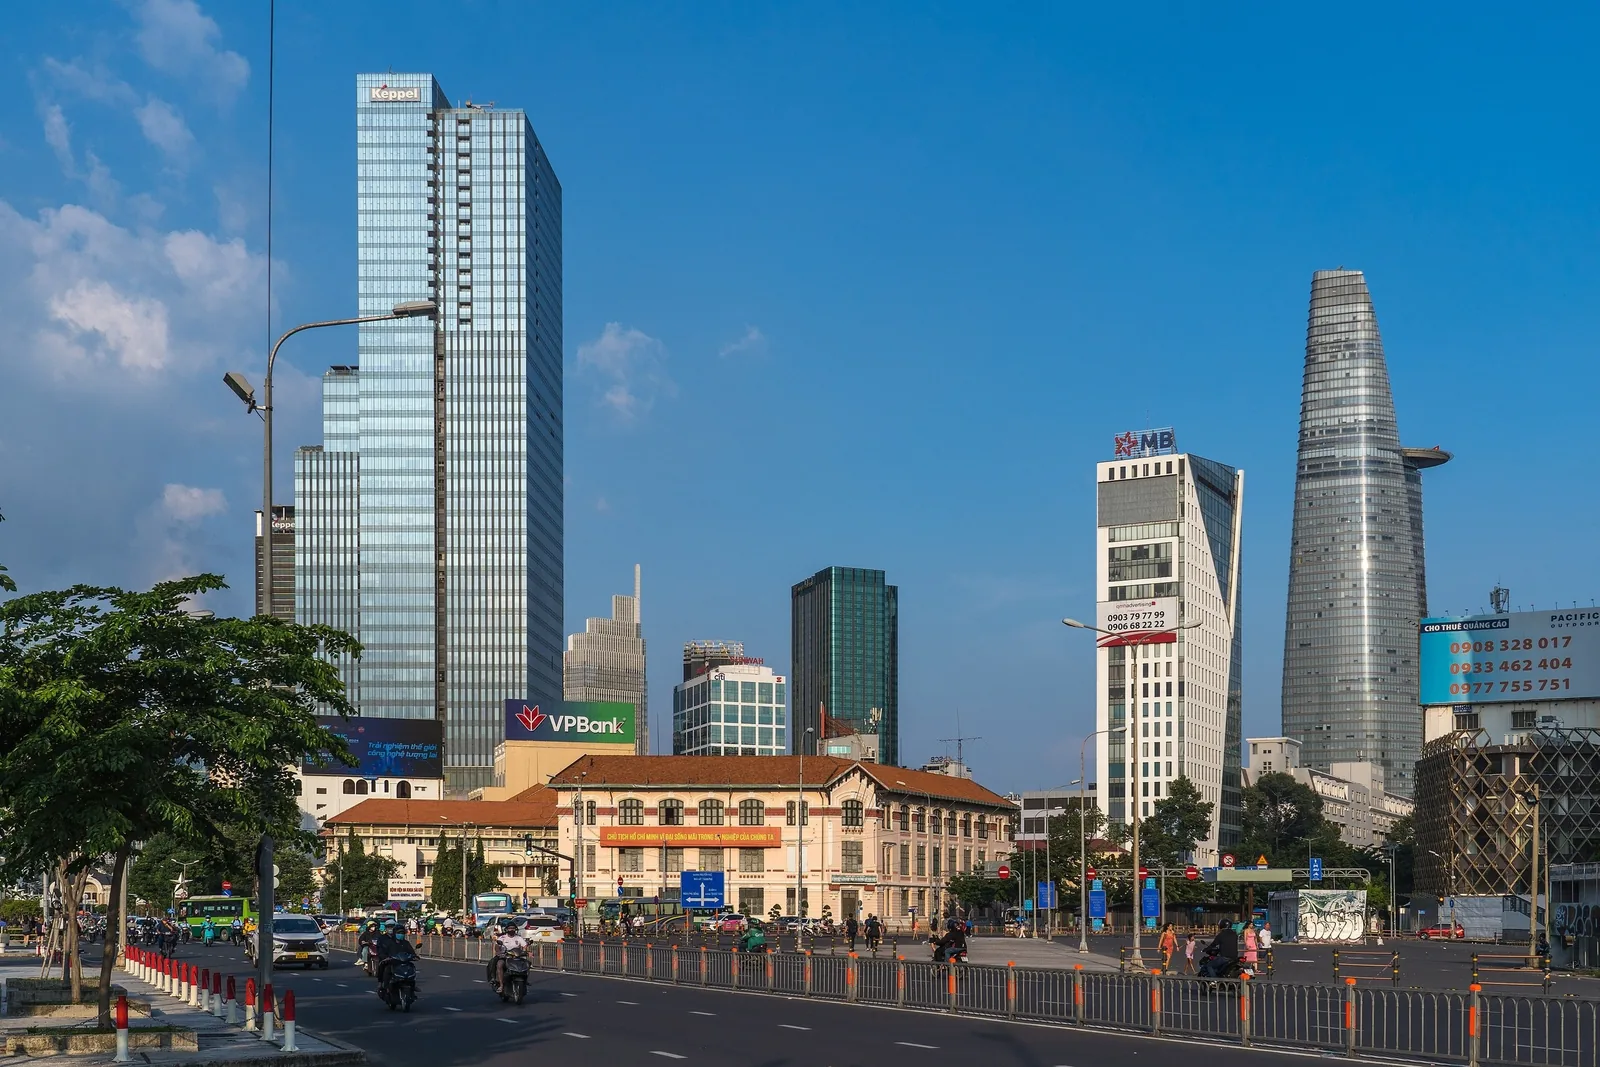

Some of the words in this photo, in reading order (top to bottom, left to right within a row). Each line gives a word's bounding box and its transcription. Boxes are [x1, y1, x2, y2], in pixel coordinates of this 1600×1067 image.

[371, 88, 418, 101] Keppel
[1140, 431, 1174, 451] MB
[1107, 613, 1128, 622] 0903
[1130, 612, 1140, 620] 79
[1142, 611, 1153, 619] 77
[1154, 610, 1165, 618] 99
[1550, 612, 1600, 622] PACIFIC
[1107, 623, 1128, 631] 0906
[1130, 622, 1140, 630] 68
[1142, 621, 1153, 629] 22
[1154, 620, 1165, 628] 22
[1424, 624, 1440, 632] CHO
[1441, 622, 1462, 631] THUÊ
[1463, 621, 1490, 630] QUẢNG
[1491, 620, 1507, 628] CÁO
[1550, 621, 1600, 629] OUTDOOR
[1450, 640, 1494, 654] 0908
[1500, 638, 1533, 651] 328
[1538, 635, 1572, 649] 017
[1450, 661, 1494, 675] 0933
[1499, 659, 1533, 672] 462
[1538, 657, 1572, 670] 404
[714, 672, 726, 681] citi
[1450, 681, 1494, 695] 0977
[1500, 680, 1533, 693] 755
[1538, 678, 1570, 691] 751
[549, 714, 625, 734] VPBank
[410, 742, 423, 750] thế
[606, 831, 618, 840] CHỦ
[618, 833, 629, 842] TỊCH
[629, 831, 637, 840] HỒ
[637, 832, 646, 840] CHÍ
[674, 831, 688, 840] SỐNG
[687, 832, 698, 840] MÃI
[721, 832, 740, 842] NGHIỆP
[740, 832, 750, 840] CỦA
[750, 832, 767, 840] CHÚNG
